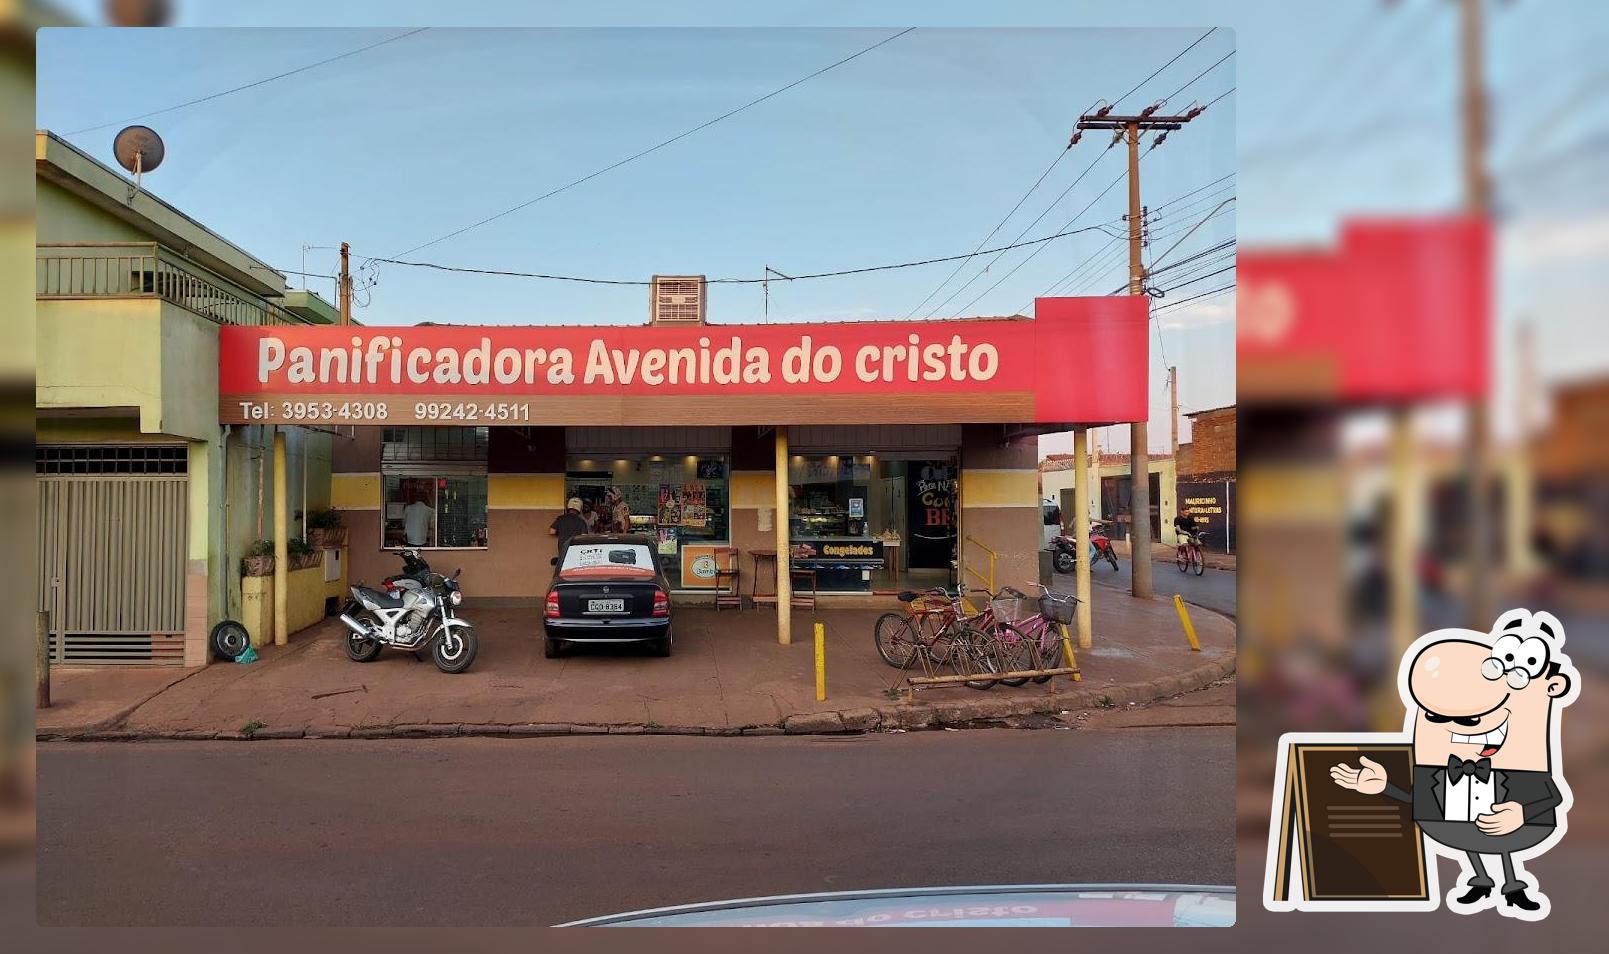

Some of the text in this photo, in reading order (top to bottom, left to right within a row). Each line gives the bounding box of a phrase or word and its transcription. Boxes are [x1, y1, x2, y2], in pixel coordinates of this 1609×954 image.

[258, 332, 999, 386] Panificadora Avenida do cristo
[239, 401, 531, 421] Tel: 3953-4308 99242-4511
[823, 545, 874, 557] Congelados
